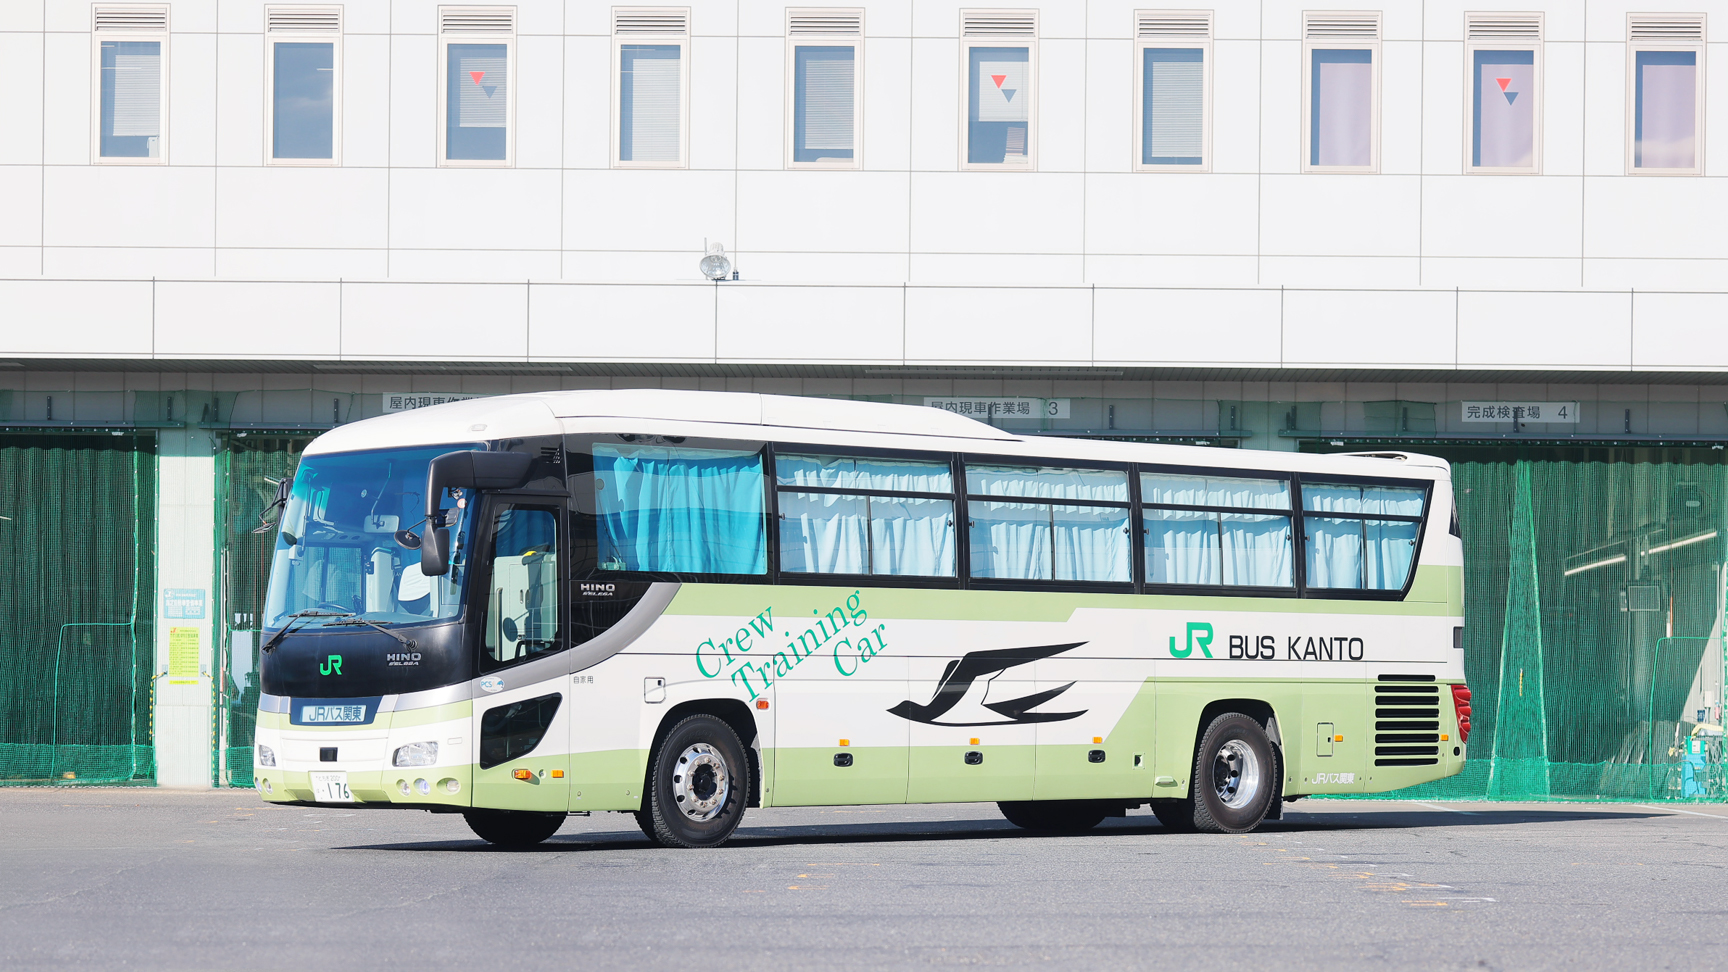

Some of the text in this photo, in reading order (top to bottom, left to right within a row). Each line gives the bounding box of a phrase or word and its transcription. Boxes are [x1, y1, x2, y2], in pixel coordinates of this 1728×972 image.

[389, 396, 481, 409] 屋内現車
[1048, 401, 1059, 416] 3
[1467, 405, 1568, 419] 完成検査場 4
[580, 583, 616, 592] HINO
[695, 606, 774, 679] Crew
[730, 590, 868, 703] Training
[1169, 622, 1364, 661] JR BUS KANTO
[386, 652, 422, 661] HINO
[833, 623, 888, 677] Car
[319, 654, 343, 676] JR
[308, 706, 363, 722] JRバス関東
[1311, 772, 1356, 785] JRバス関東
[327, 782, 350, 799] 176
